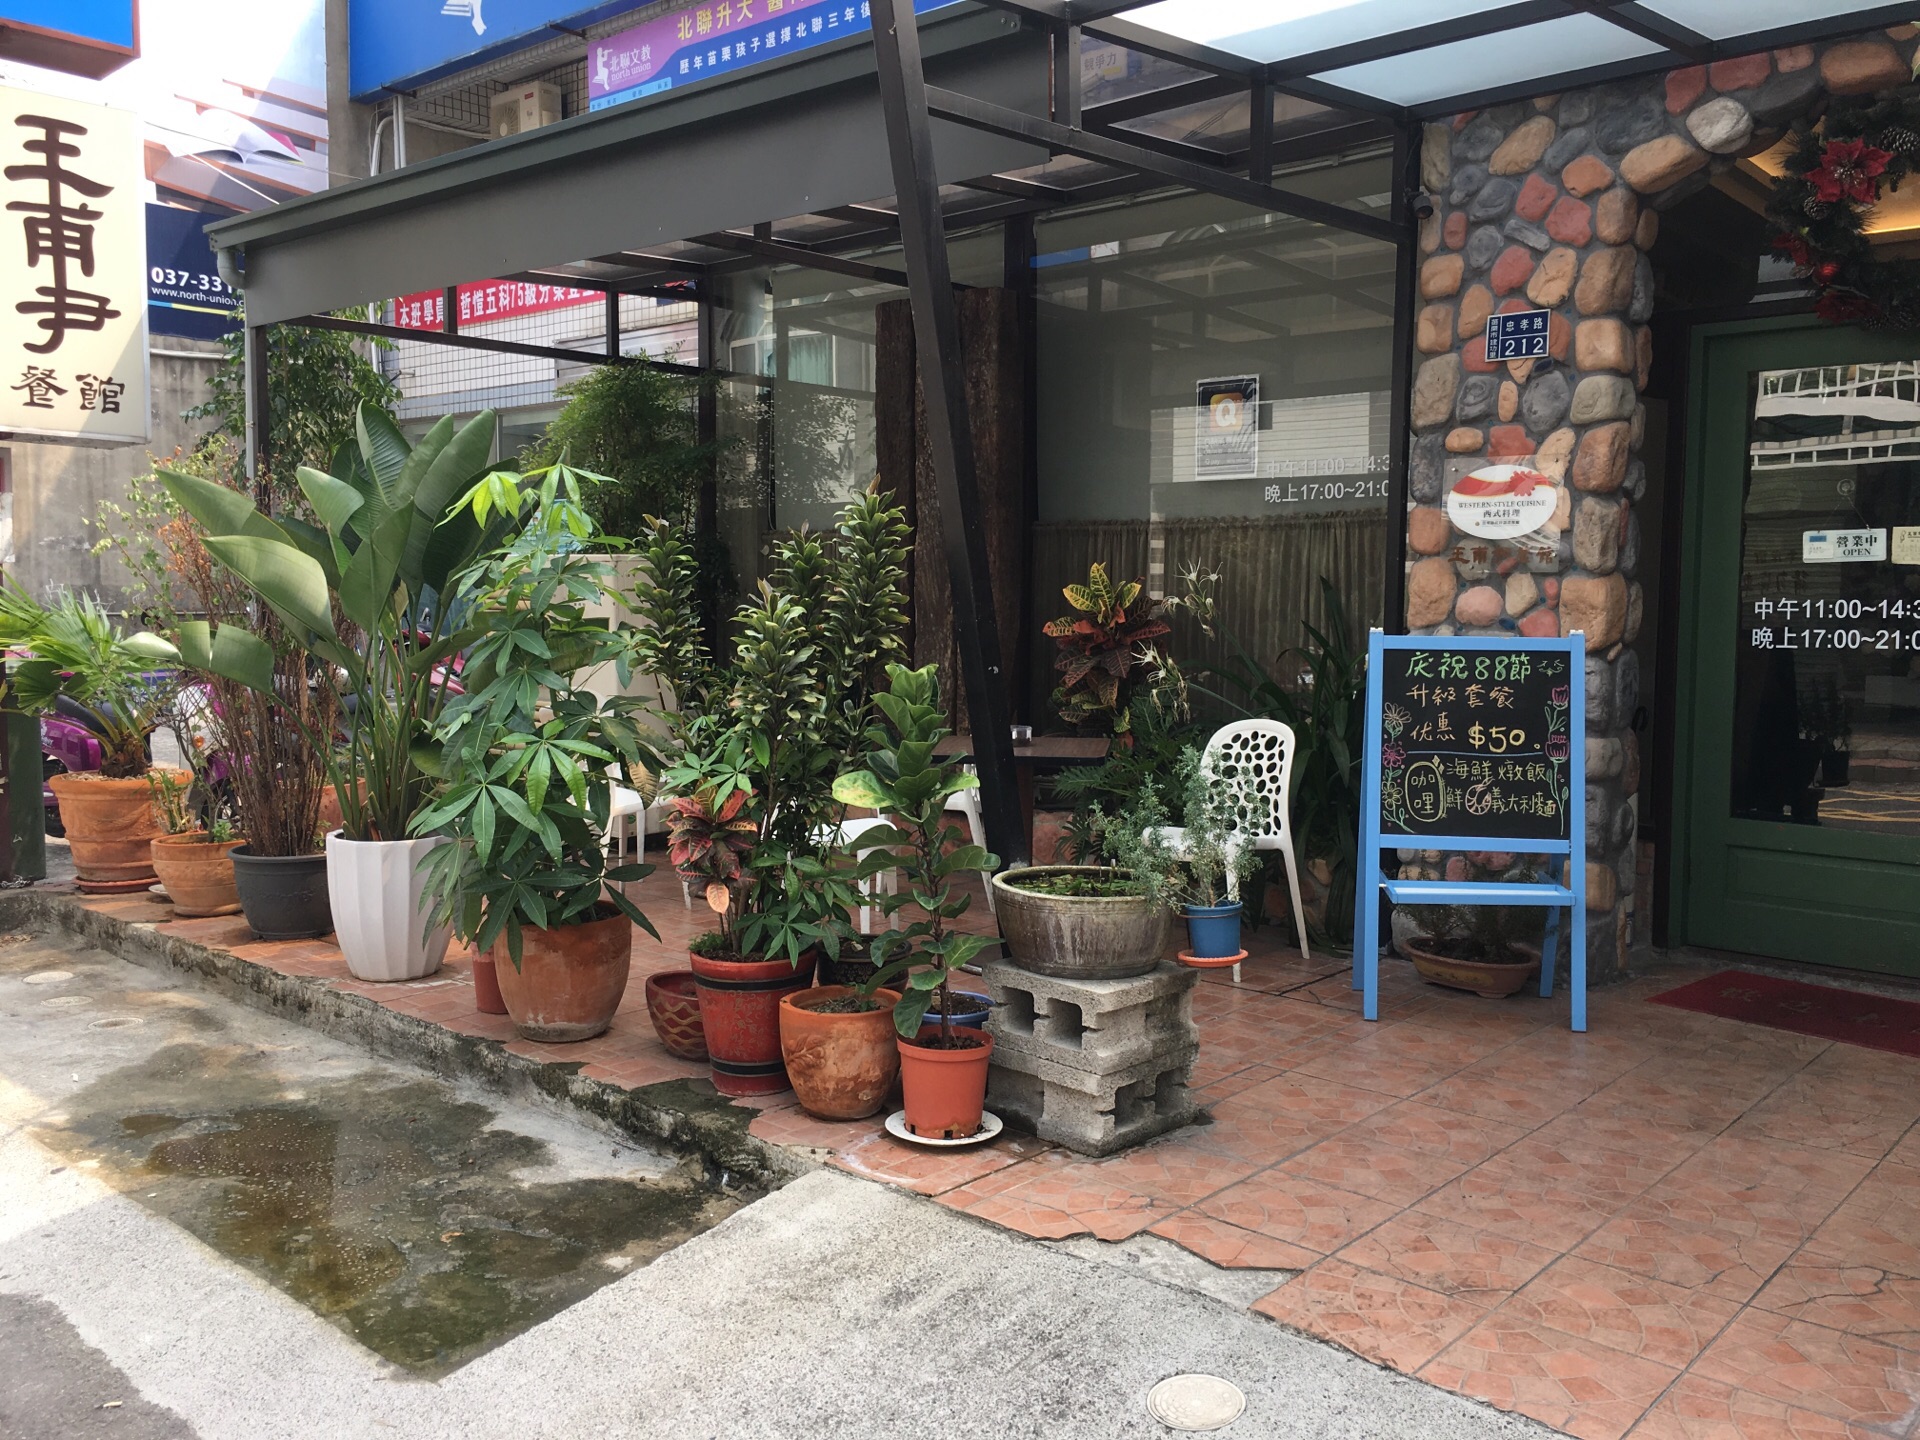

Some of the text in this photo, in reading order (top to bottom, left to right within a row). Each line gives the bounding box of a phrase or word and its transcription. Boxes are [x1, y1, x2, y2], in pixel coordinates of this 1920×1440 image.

[609, 44, 651, 72] 北聯文教
[611, 69, 631, 81] north
[631, 62, 652, 75] union
[1505, 317, 1543, 332] 忠孝路
[1504, 337, 1544, 356] 212
[10, 365, 126, 414] 餐館
[1517, 499, 1547, 508] CUISINE
[1483, 509, 1521, 518] 西式料理
[1836, 534, 1878, 548] 營業中
[1842, 548, 1872, 557] OPEN
